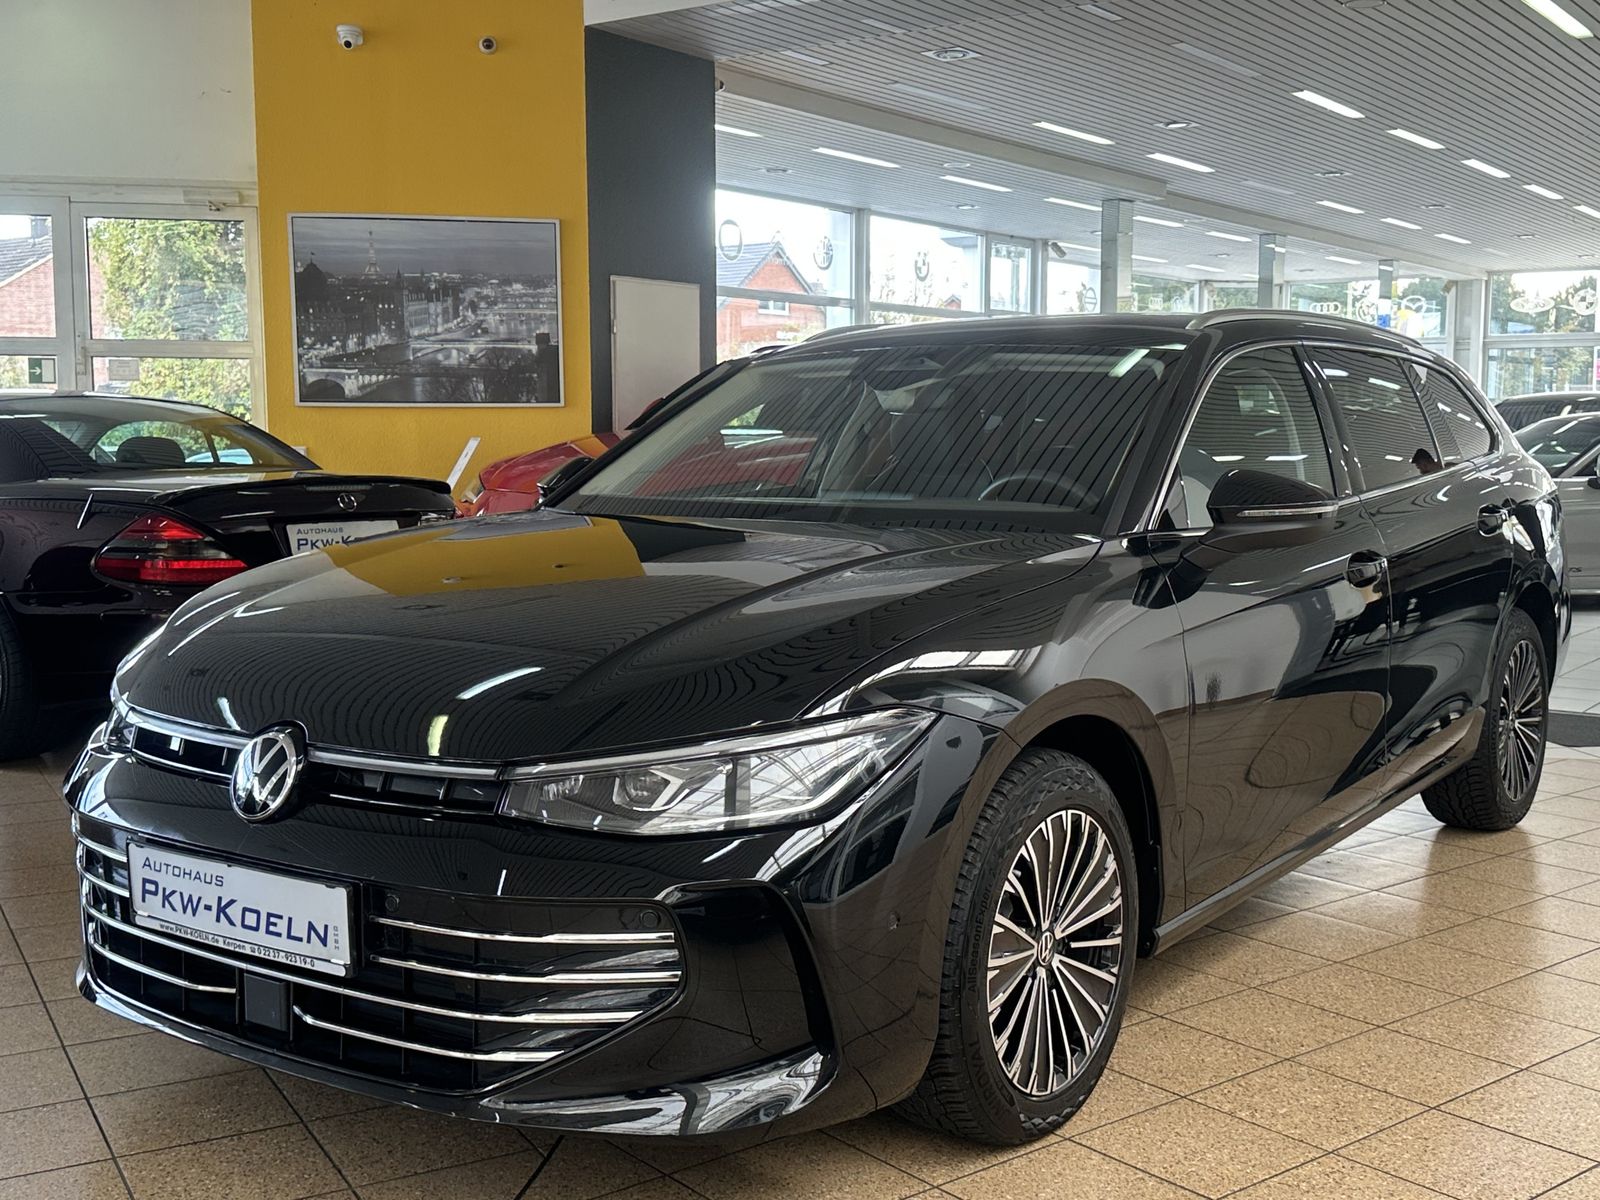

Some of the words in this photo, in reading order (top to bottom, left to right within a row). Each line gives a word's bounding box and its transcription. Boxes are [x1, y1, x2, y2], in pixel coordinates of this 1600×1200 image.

[296, 527, 344, 535] AUTOHAUS
[142, 856, 224, 887] AUTOHAUS
[141, 877, 329, 947] PKW-KOELN
[222, 938, 247, 952] Kerpen
